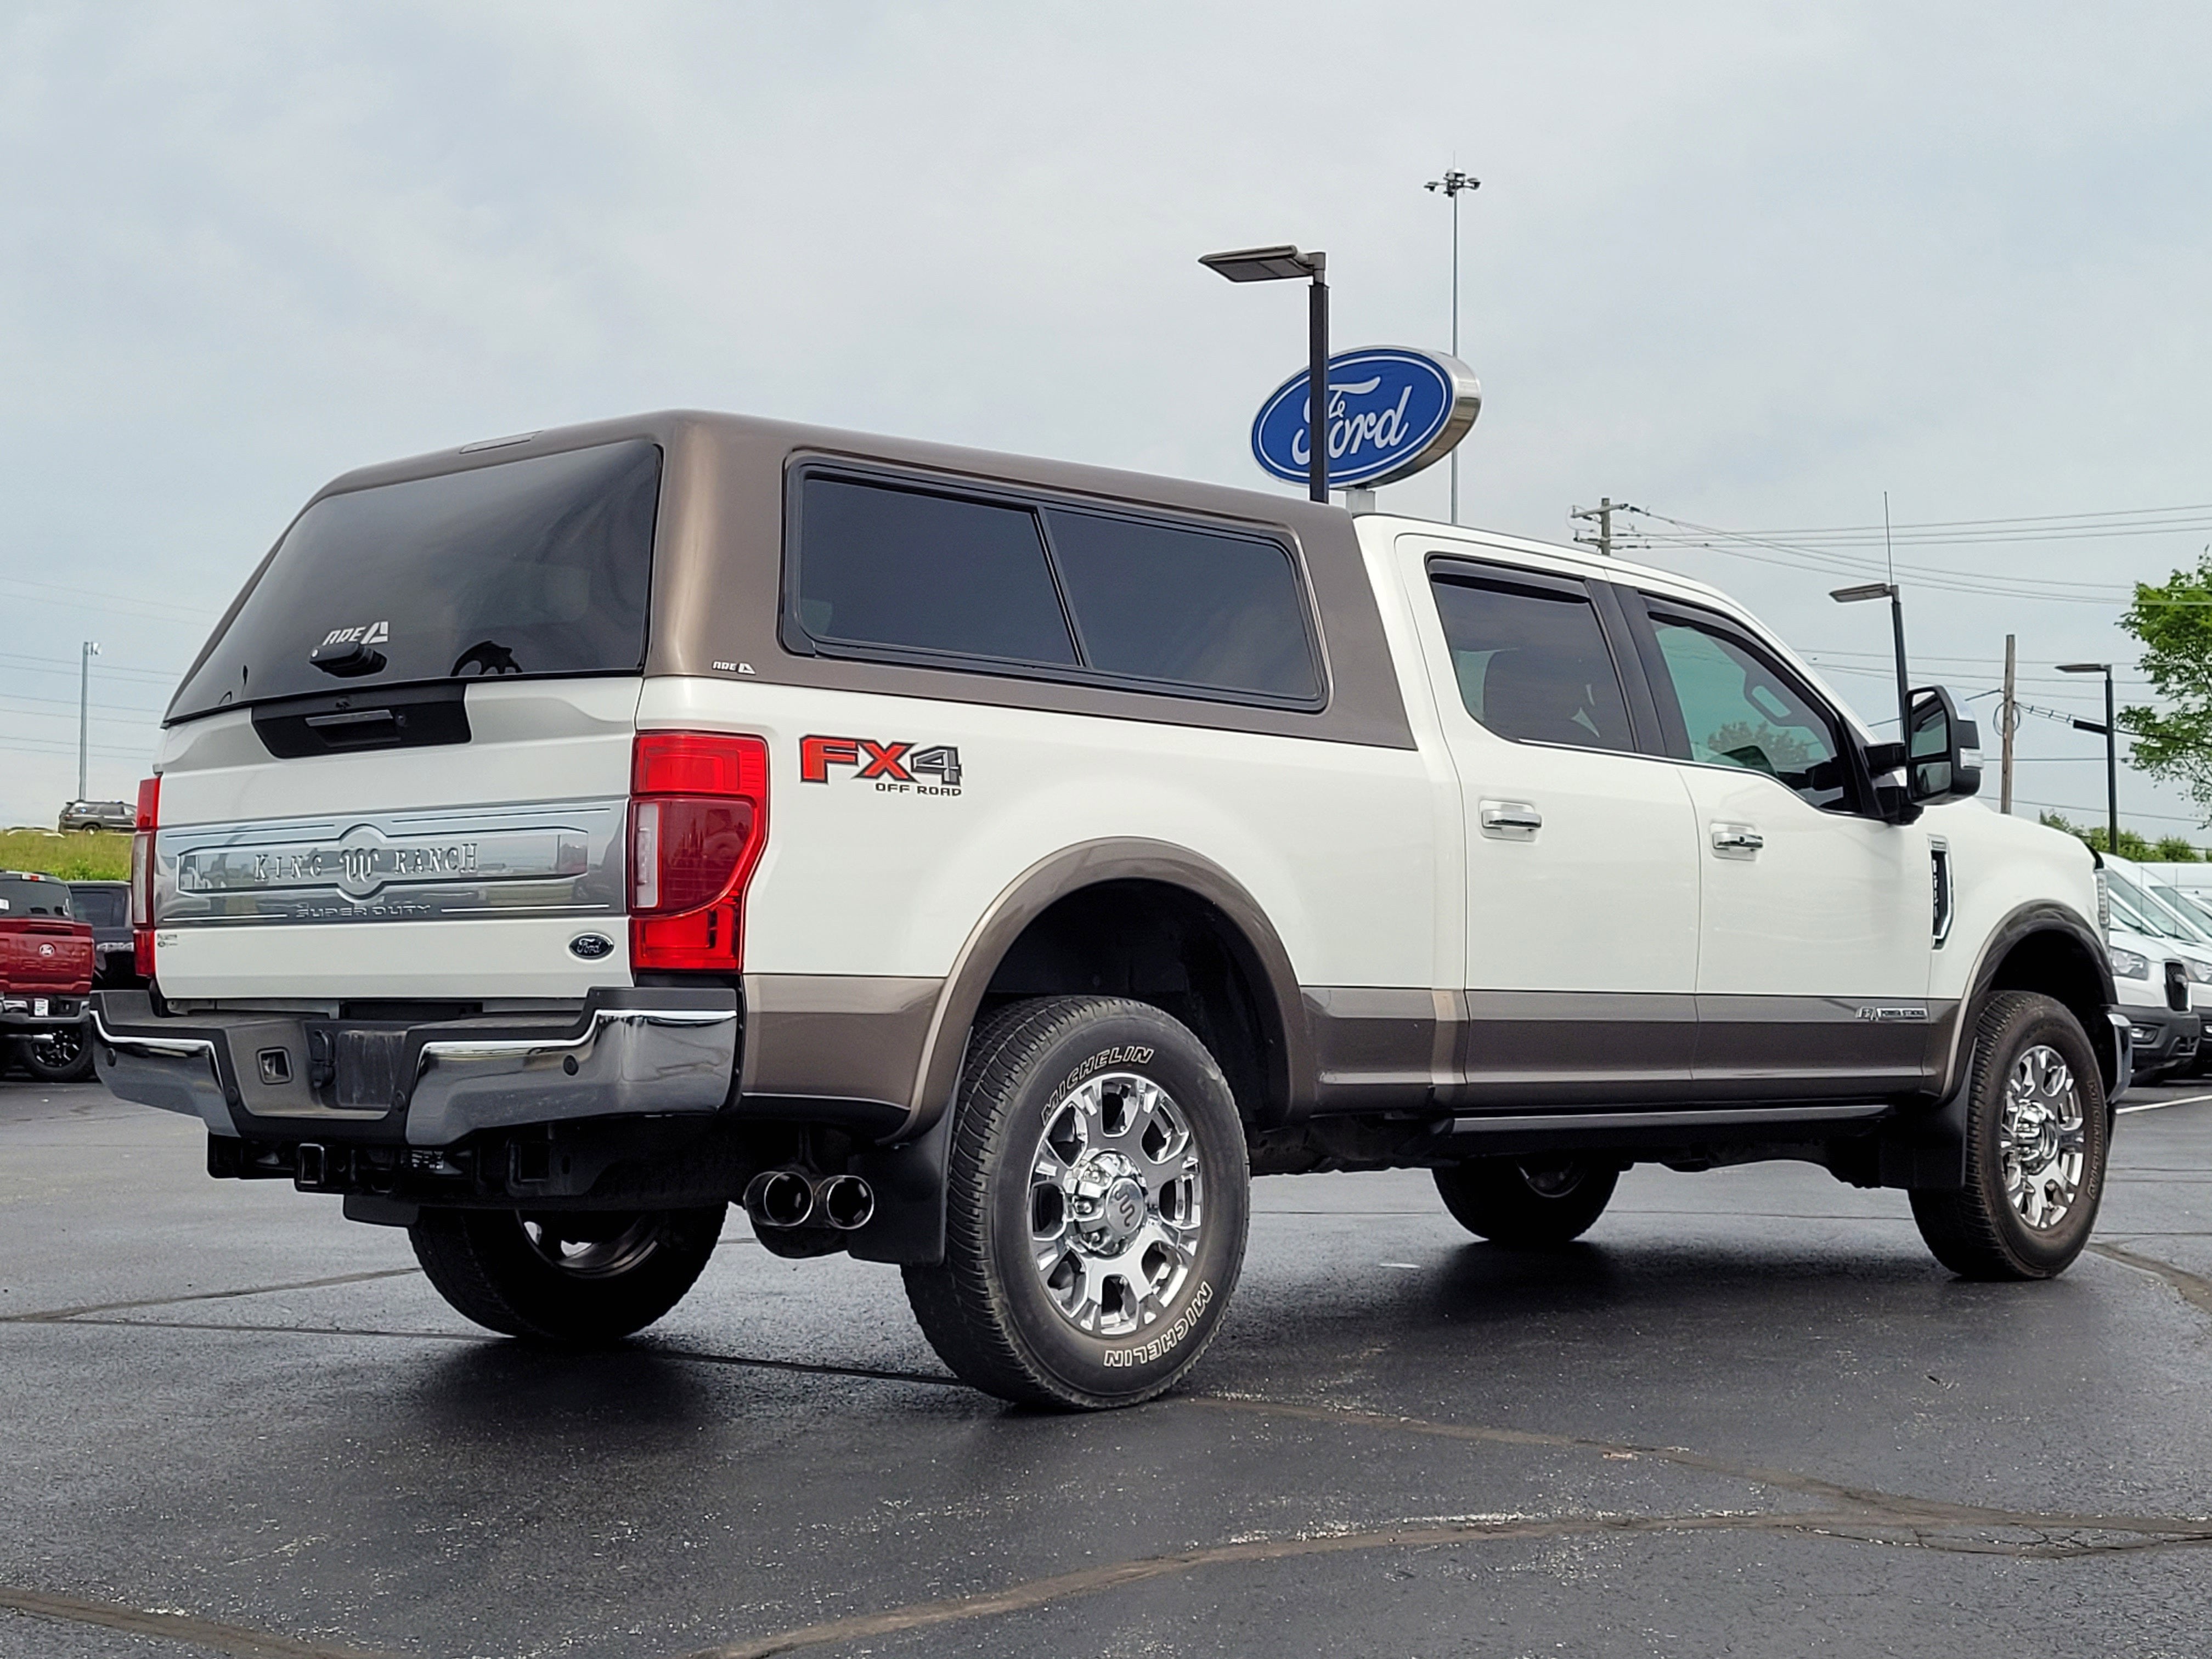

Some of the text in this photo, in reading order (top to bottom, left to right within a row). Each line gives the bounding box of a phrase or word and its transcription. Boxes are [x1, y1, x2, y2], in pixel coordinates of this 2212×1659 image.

[1292, 376, 1413, 465] Ford
[799, 734, 962, 786] FX4
[875, 782, 962, 797] OFF ROAD
[253, 843, 478, 882] KING RANCH
[296, 905, 431, 918] SUPER DUTY
[577, 938, 602, 953] Ford
[1041, 1046, 1154, 1125] MICHELIN
[1103, 1280, 1214, 1367] MICHELIN
